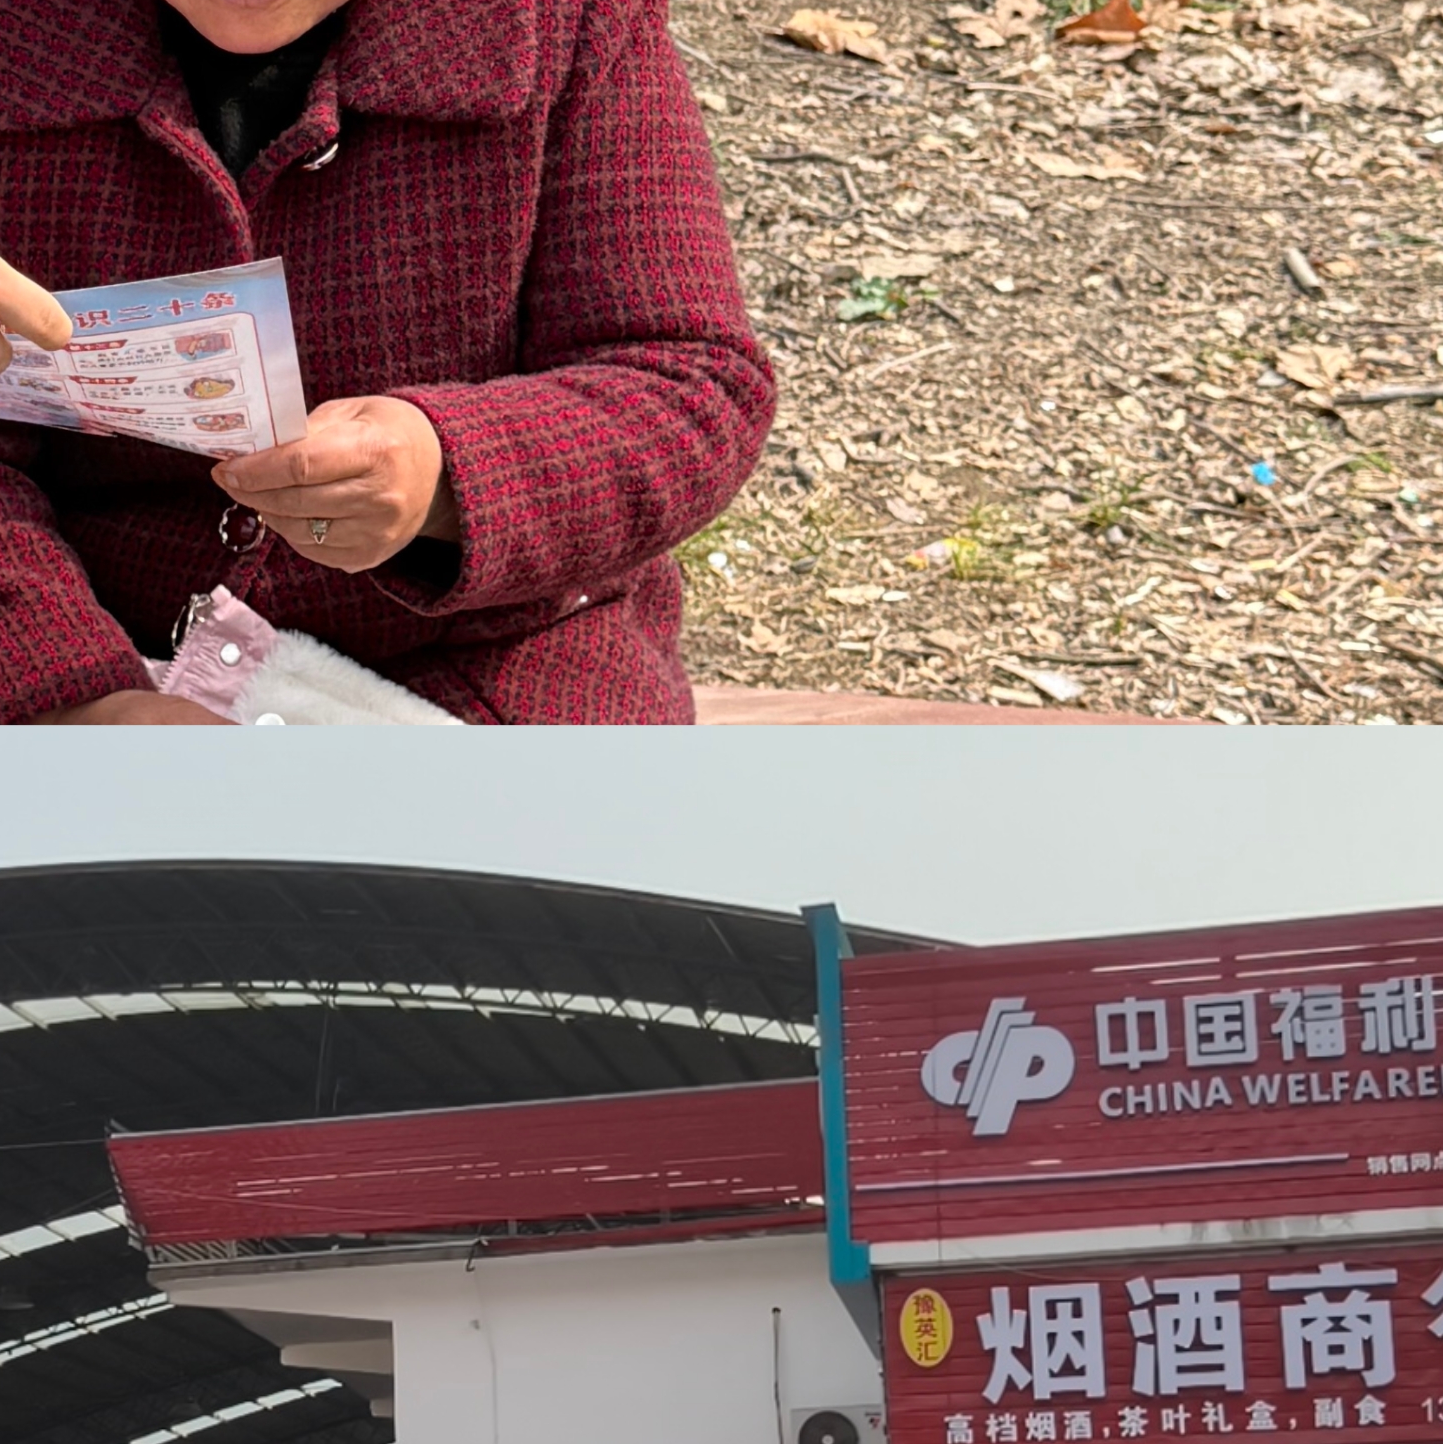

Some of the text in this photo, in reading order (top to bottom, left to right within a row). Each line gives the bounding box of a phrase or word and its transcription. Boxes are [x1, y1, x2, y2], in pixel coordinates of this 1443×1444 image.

[1094, 974, 1438, 1070] 中国福利
[1098, 1082, 1232, 1118] CHINA
